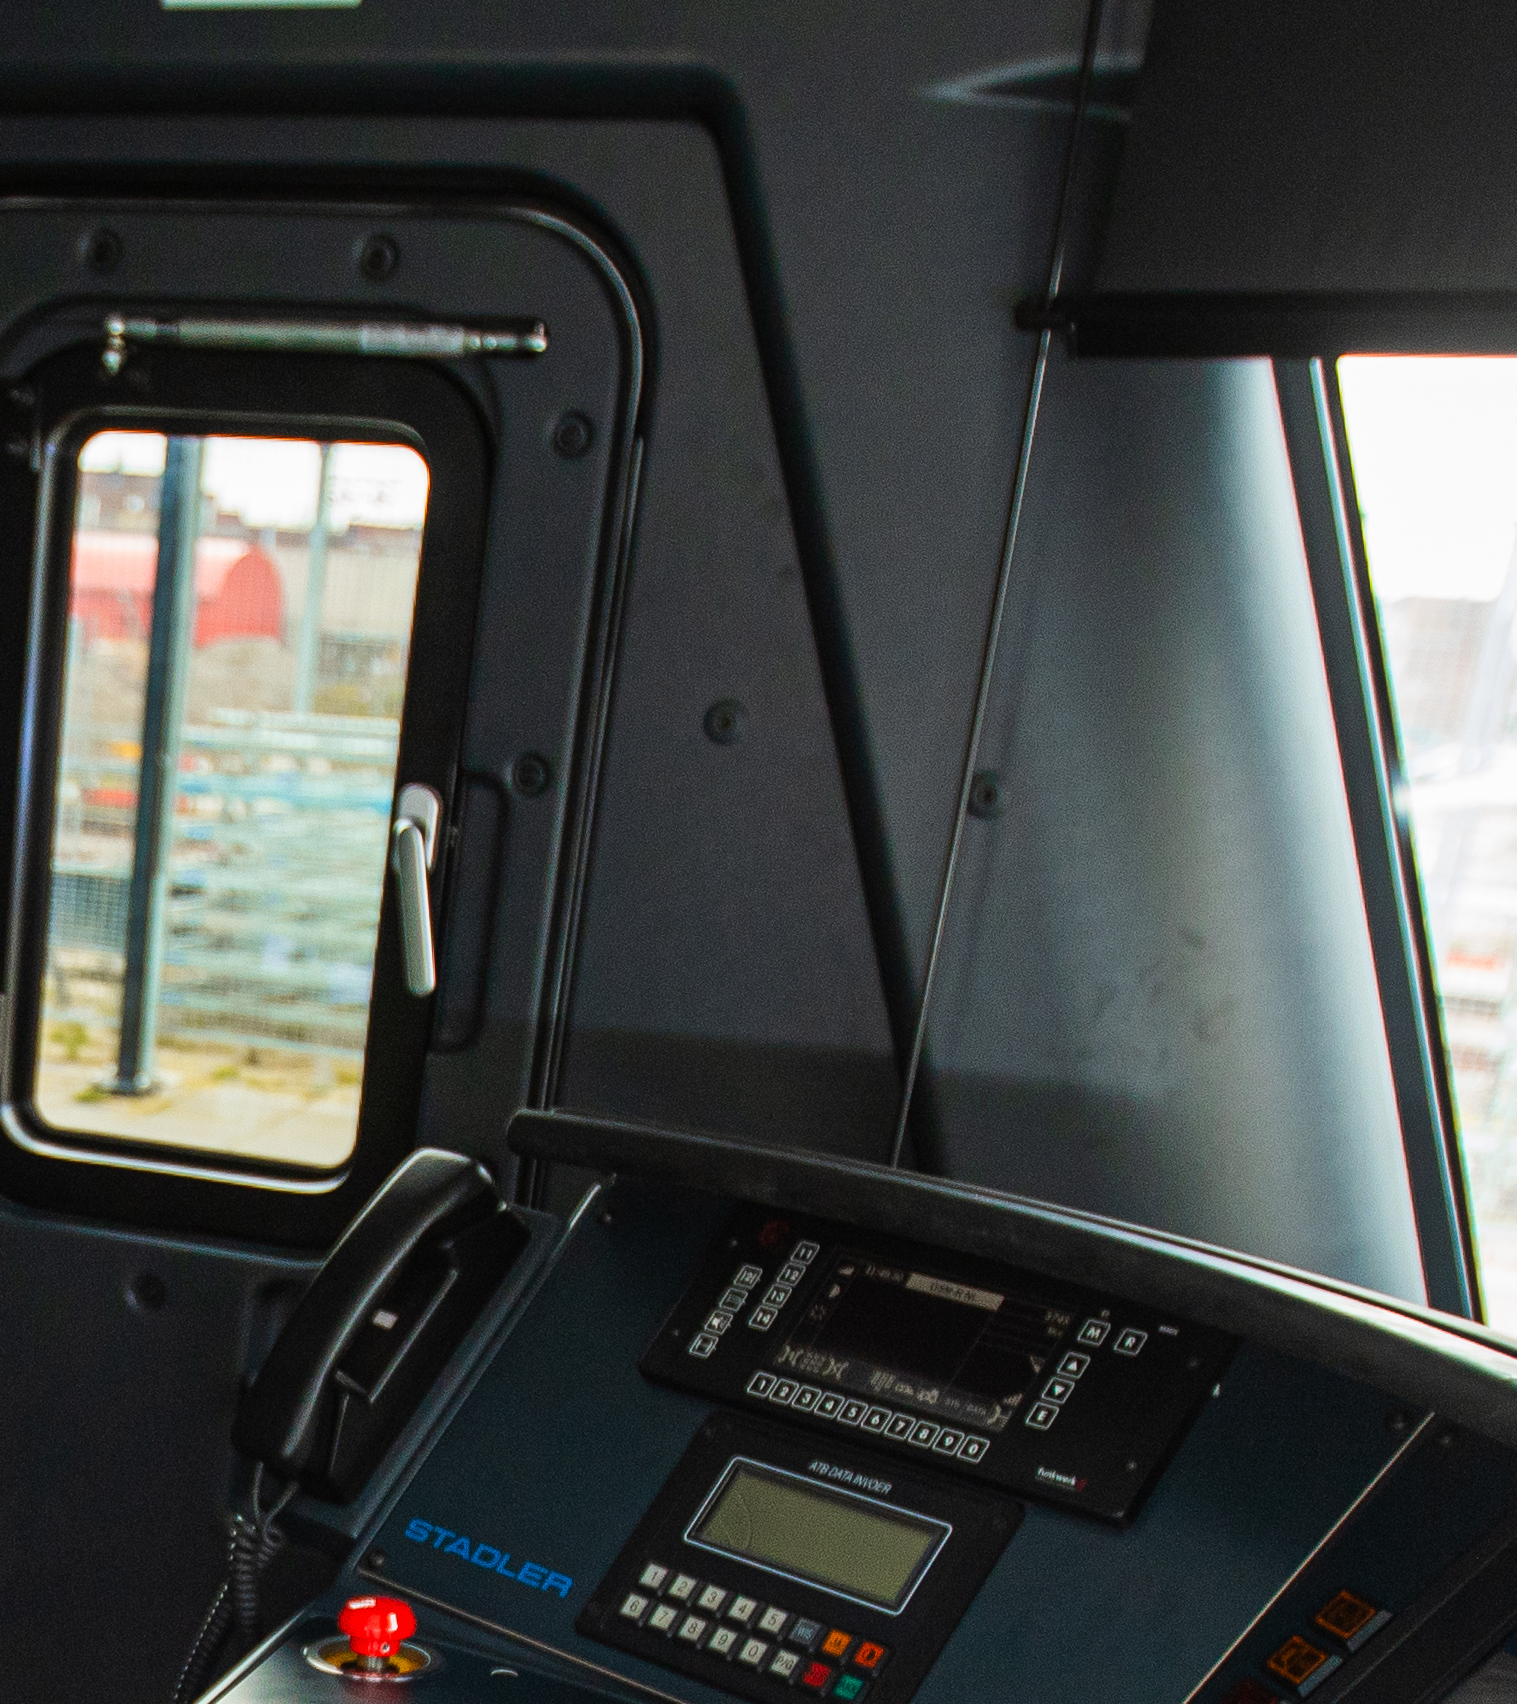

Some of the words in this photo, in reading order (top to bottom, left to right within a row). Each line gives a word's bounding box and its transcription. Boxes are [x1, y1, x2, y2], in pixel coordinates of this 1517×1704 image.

[808, 1461, 830, 1475] ATB
[828, 1466, 854, 1482] DATA
[404, 1517, 574, 1598] STADLER
